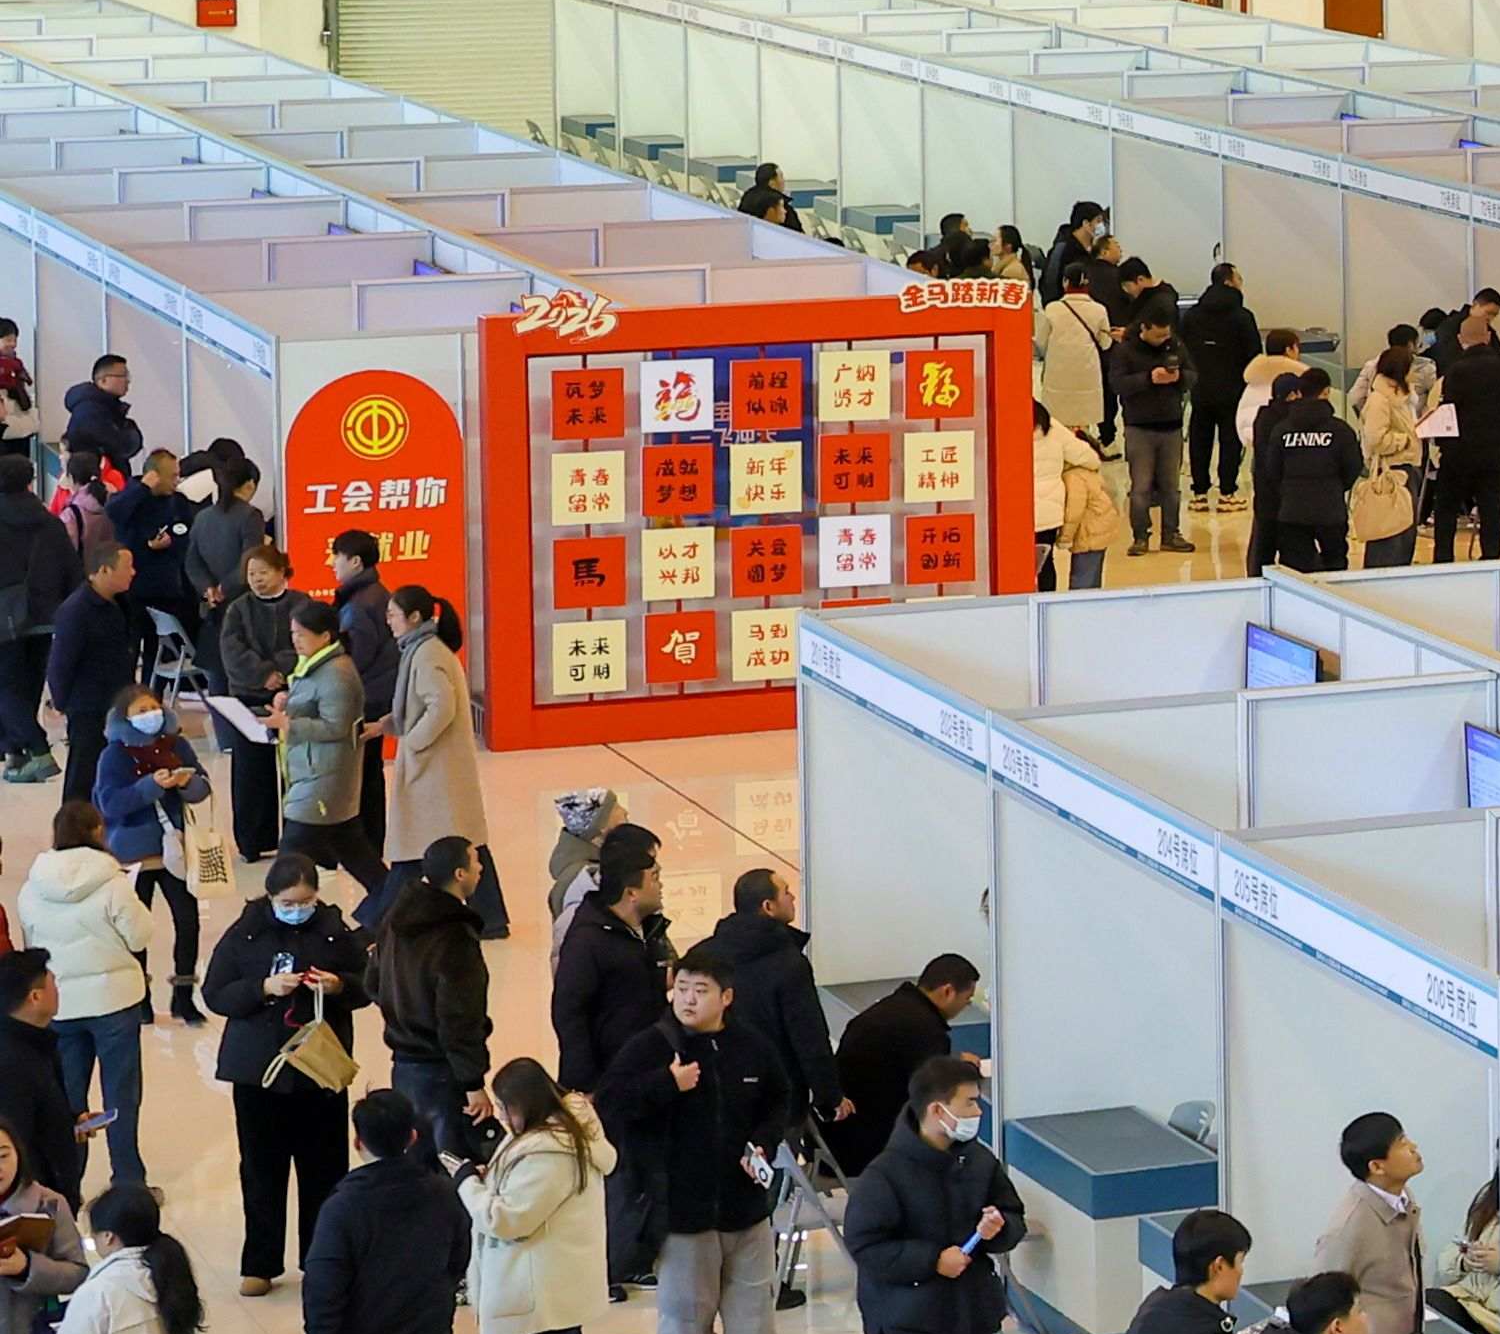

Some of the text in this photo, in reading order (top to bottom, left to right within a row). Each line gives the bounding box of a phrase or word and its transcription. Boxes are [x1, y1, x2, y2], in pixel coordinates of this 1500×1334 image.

[902, 281, 1027, 310] 金马踏新春
[921, 445, 958, 464] 工匠
[746, 457, 788, 476] 新年
[569, 468, 610, 488] 青春
[918, 471, 960, 490] 精神
[304, 476, 448, 514] 工会帮你
[745, 483, 787, 502] 快乐
[659, 541, 700, 560] 以才
[573, 557, 606, 588] 馬
[659, 567, 701, 586] 兴邦
[748, 623, 788, 641] 马到
[569, 637, 611, 657] 未来
[747, 649, 790, 667] 成功
[1002, 744, 1040, 789] 203号席位
[1157, 827, 1199, 877] 204号席位
[1233, 868, 1280, 920] 205号席位
[1426, 971, 1479, 1030] 206号席位
